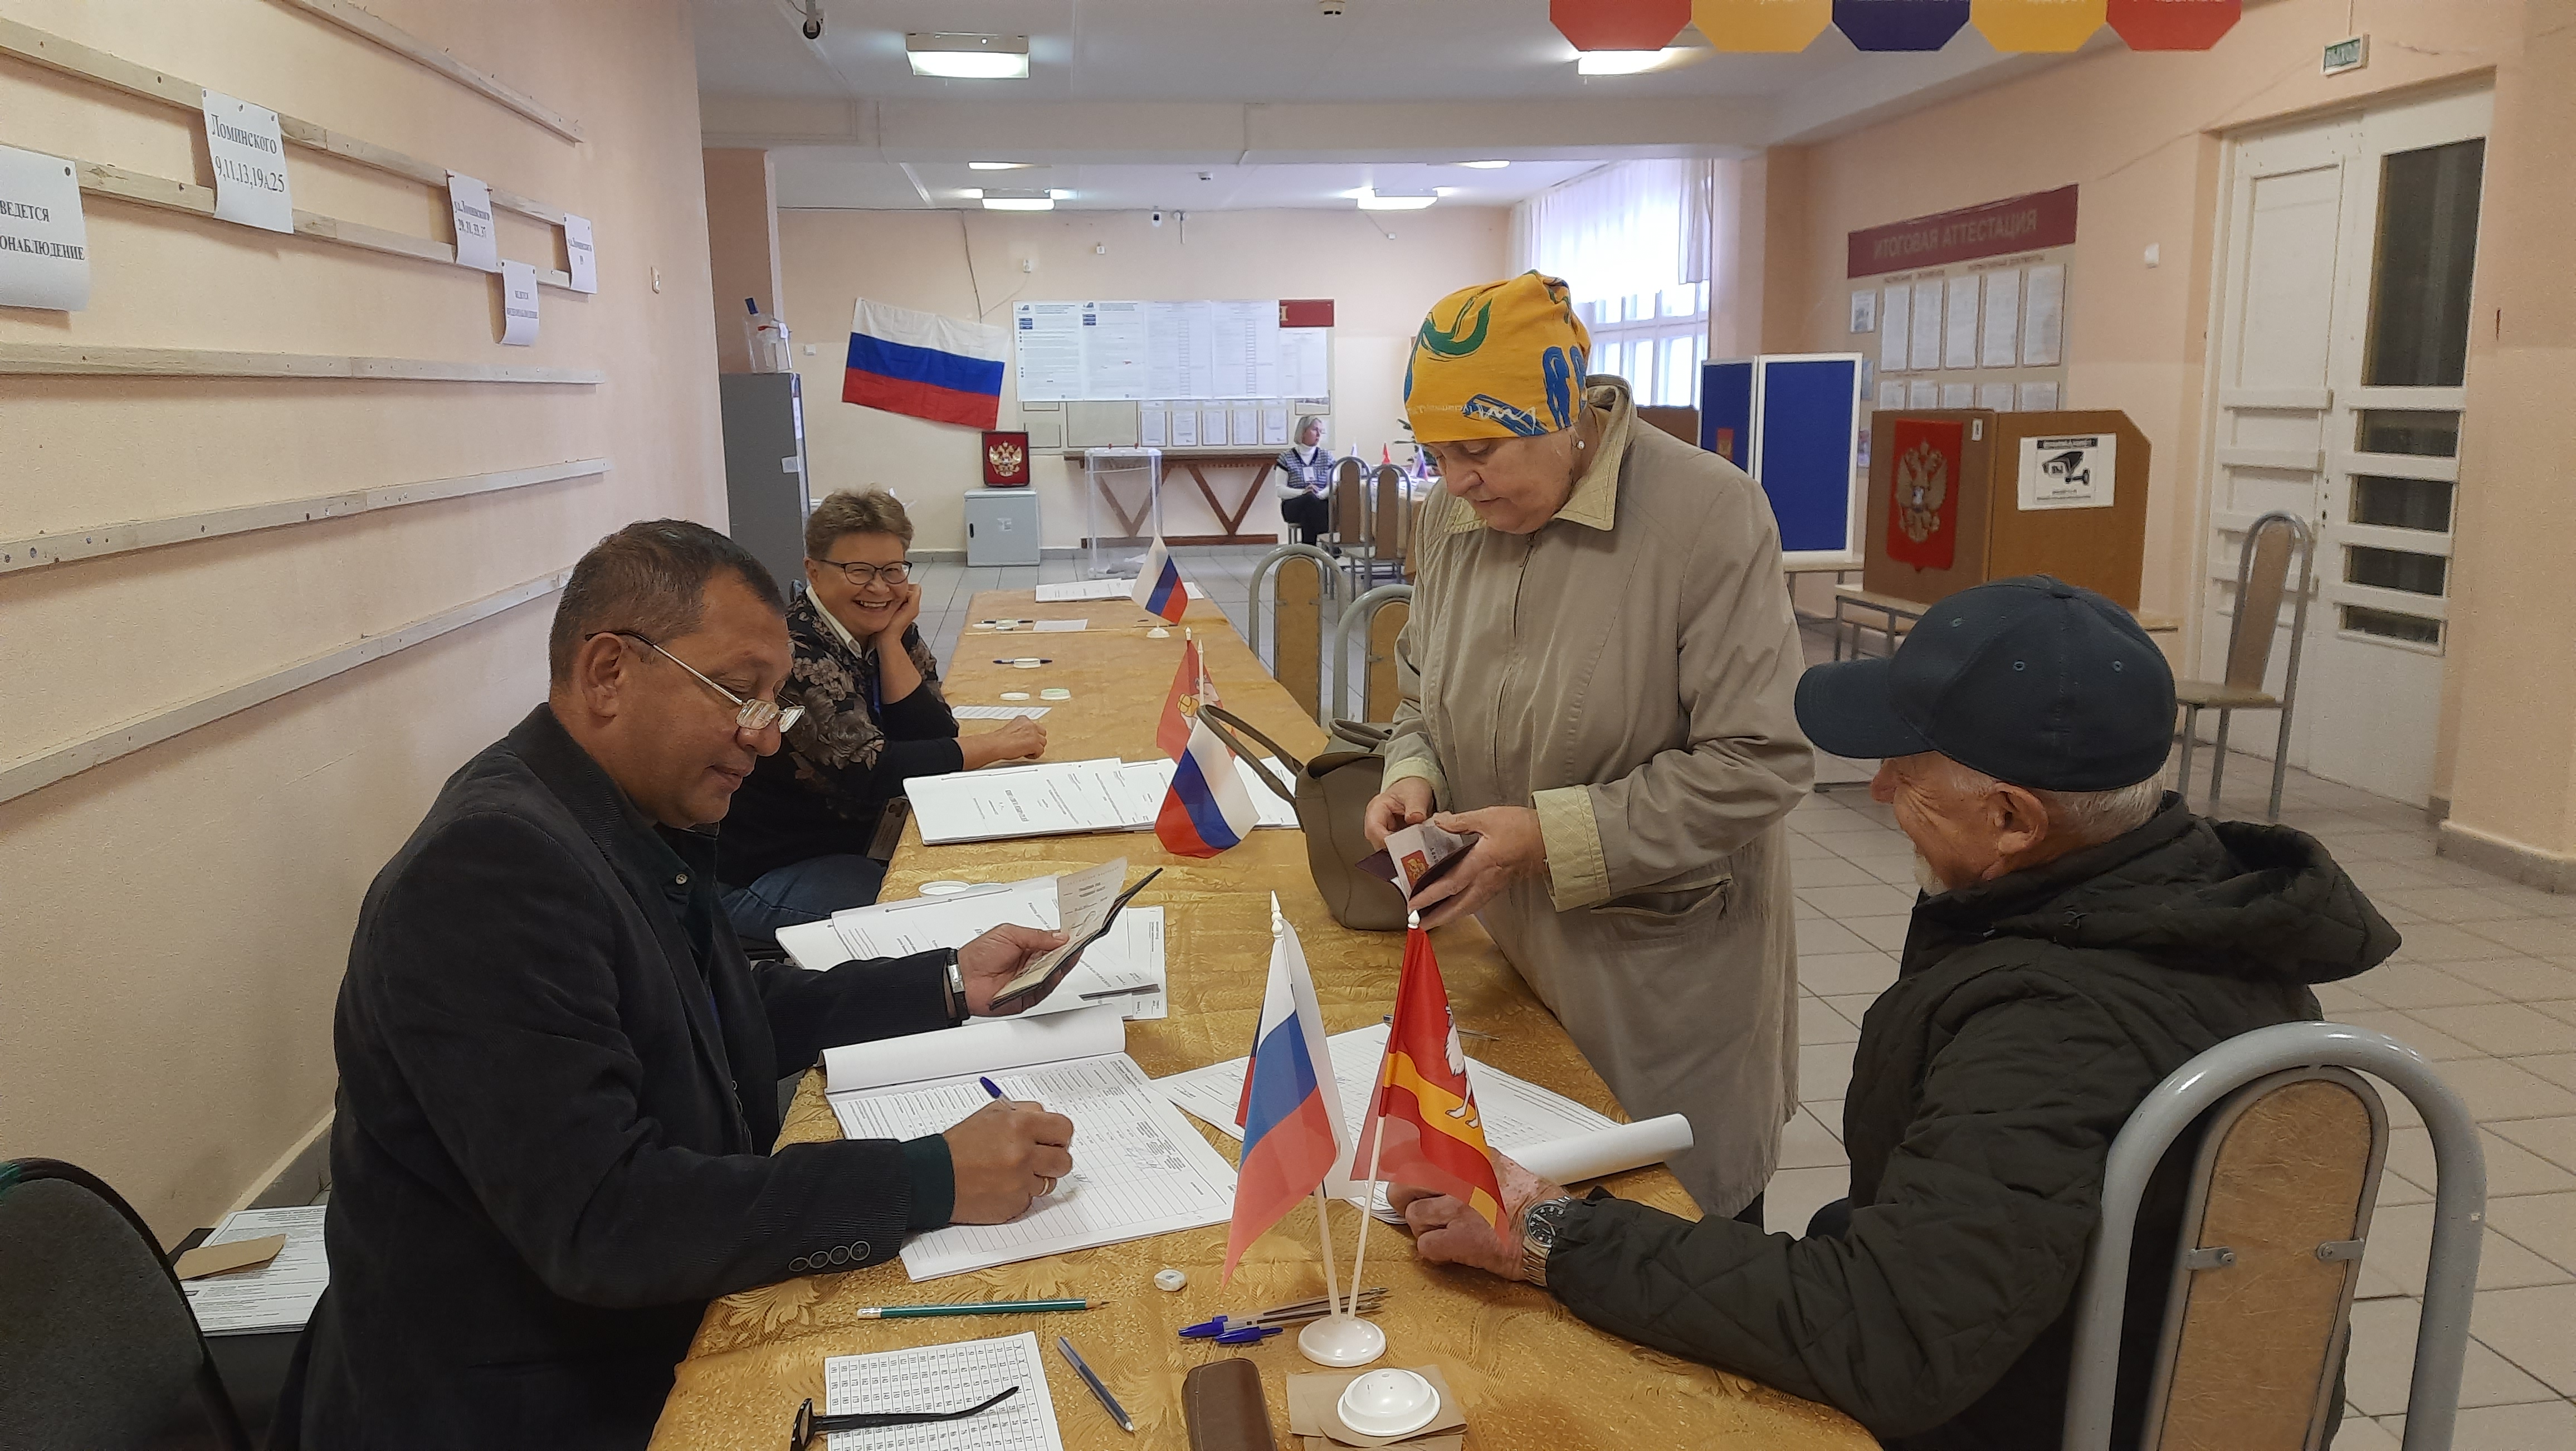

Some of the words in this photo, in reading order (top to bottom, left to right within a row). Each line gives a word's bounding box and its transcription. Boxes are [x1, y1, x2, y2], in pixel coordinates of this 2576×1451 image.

[211, 113, 277, 154] Ломинского
[0, 200, 50, 222] ВЕДЕТСЯ
[1874, 227, 1939, 260] ИТОГОВАЯ
[1942, 208, 2038, 247] АТТЕСТАЦИЯ
